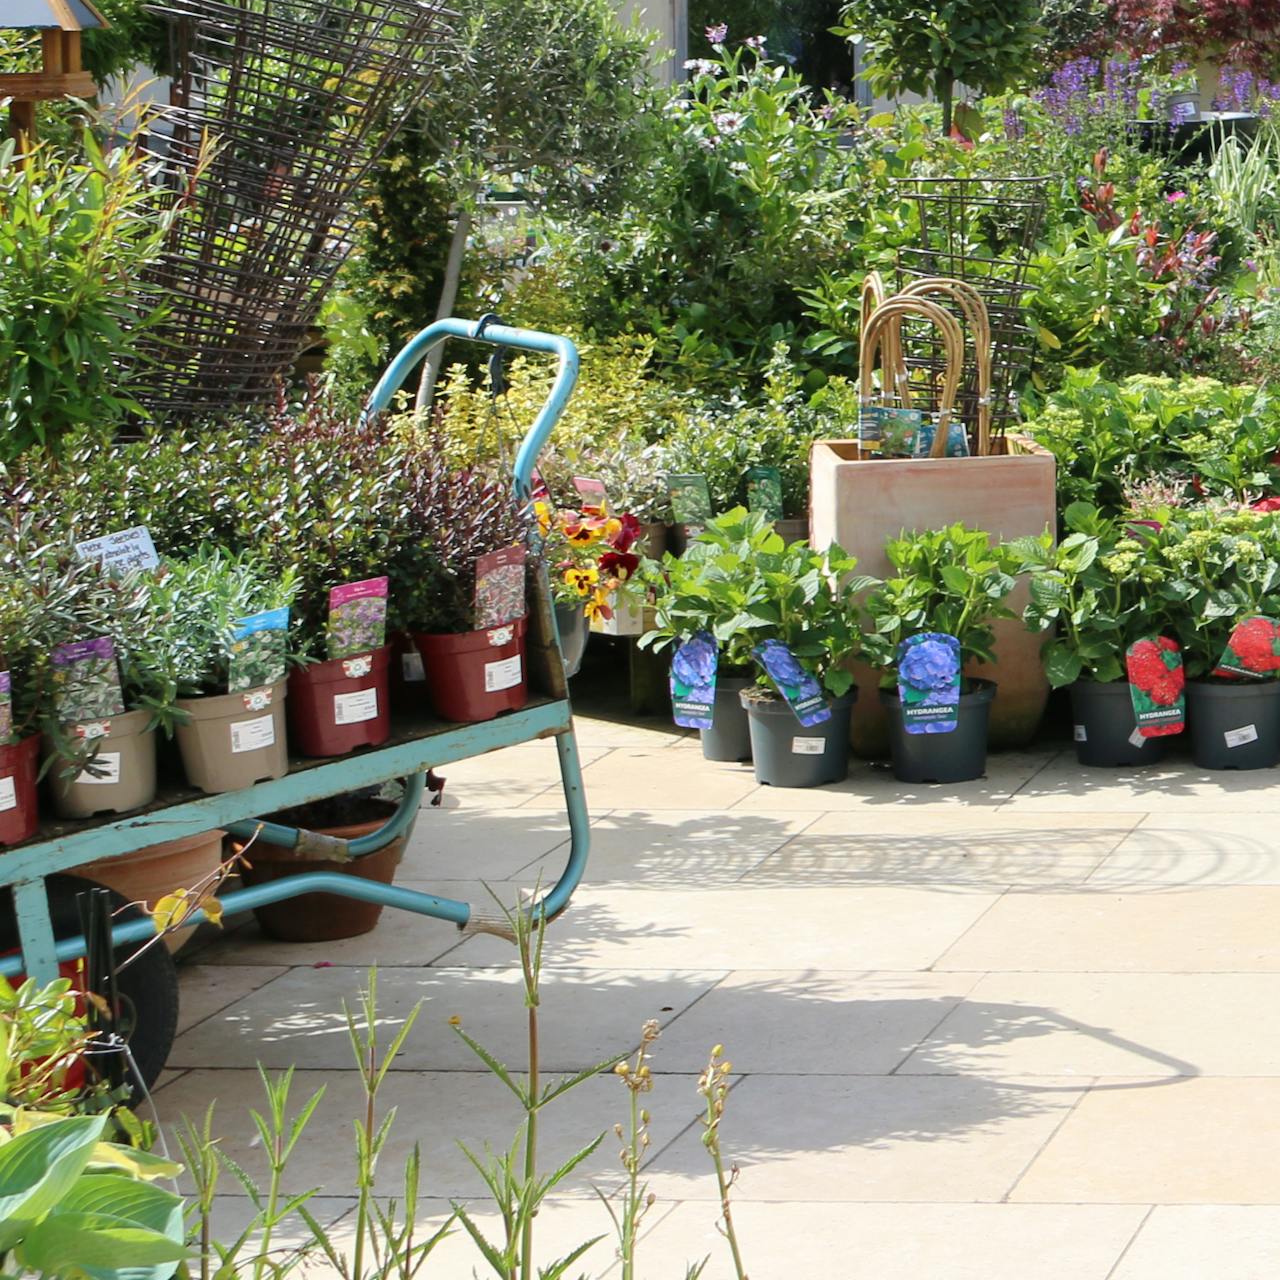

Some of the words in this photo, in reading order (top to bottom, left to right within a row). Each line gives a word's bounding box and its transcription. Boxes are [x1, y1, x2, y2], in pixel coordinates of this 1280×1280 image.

[675, 702, 711, 712] HYDRANGEA
[906, 706, 954, 716] HYDRANGEA
[1139, 709, 1182, 720] HYDRANGEA
